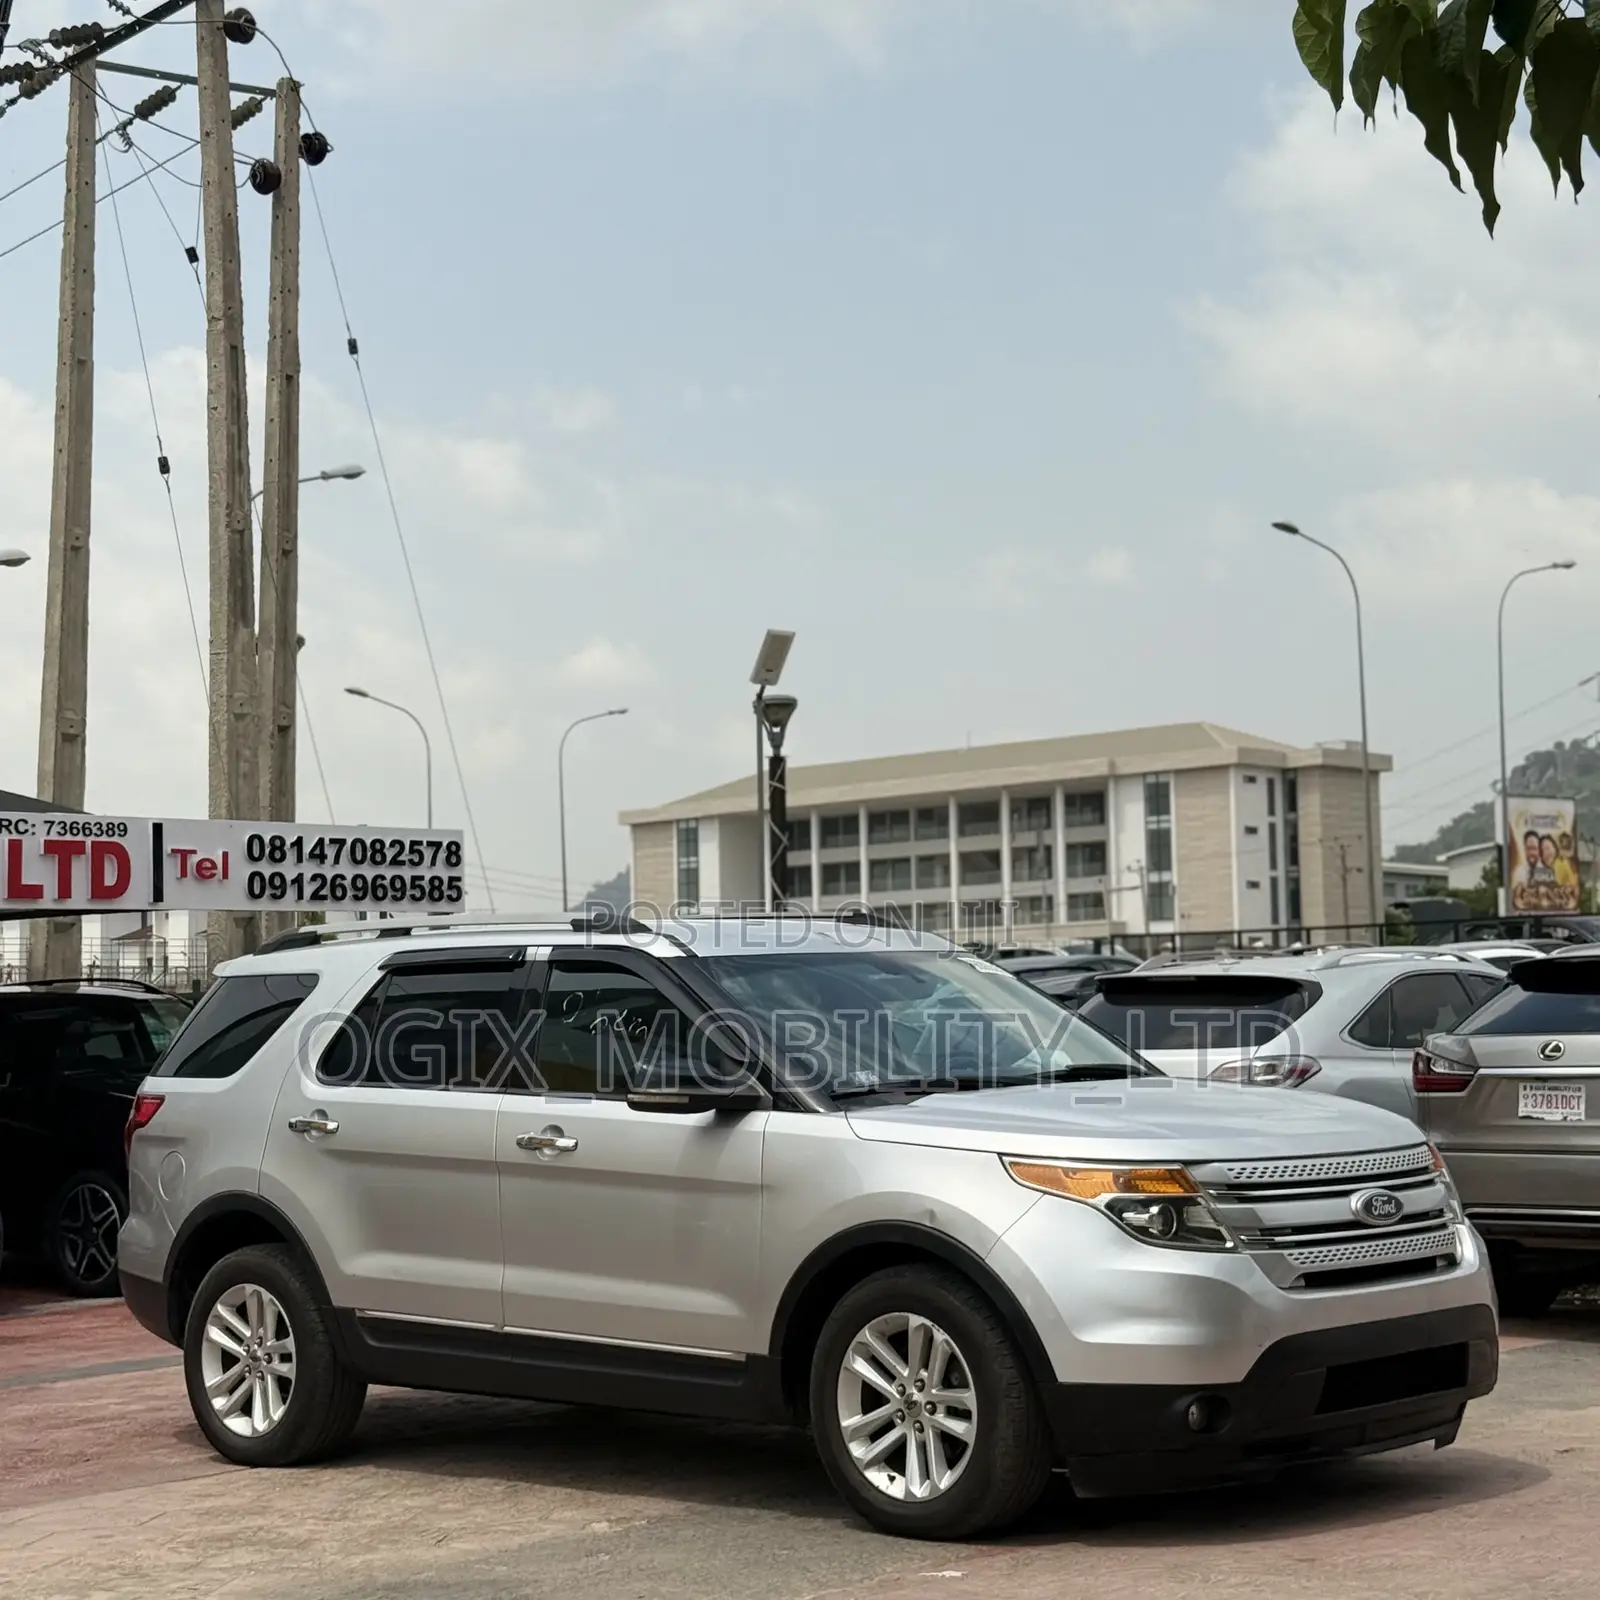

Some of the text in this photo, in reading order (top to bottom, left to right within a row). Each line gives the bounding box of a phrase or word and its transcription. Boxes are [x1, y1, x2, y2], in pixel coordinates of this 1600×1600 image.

[0, 818, 128, 838] RC: 7366389
[169, 848, 229, 880] Tel
[245, 833, 462, 868] 08147082578
[6, 838, 131, 900] LTD
[246, 870, 463, 903] 09126969585
[1371, 1196, 1397, 1216] Ford
